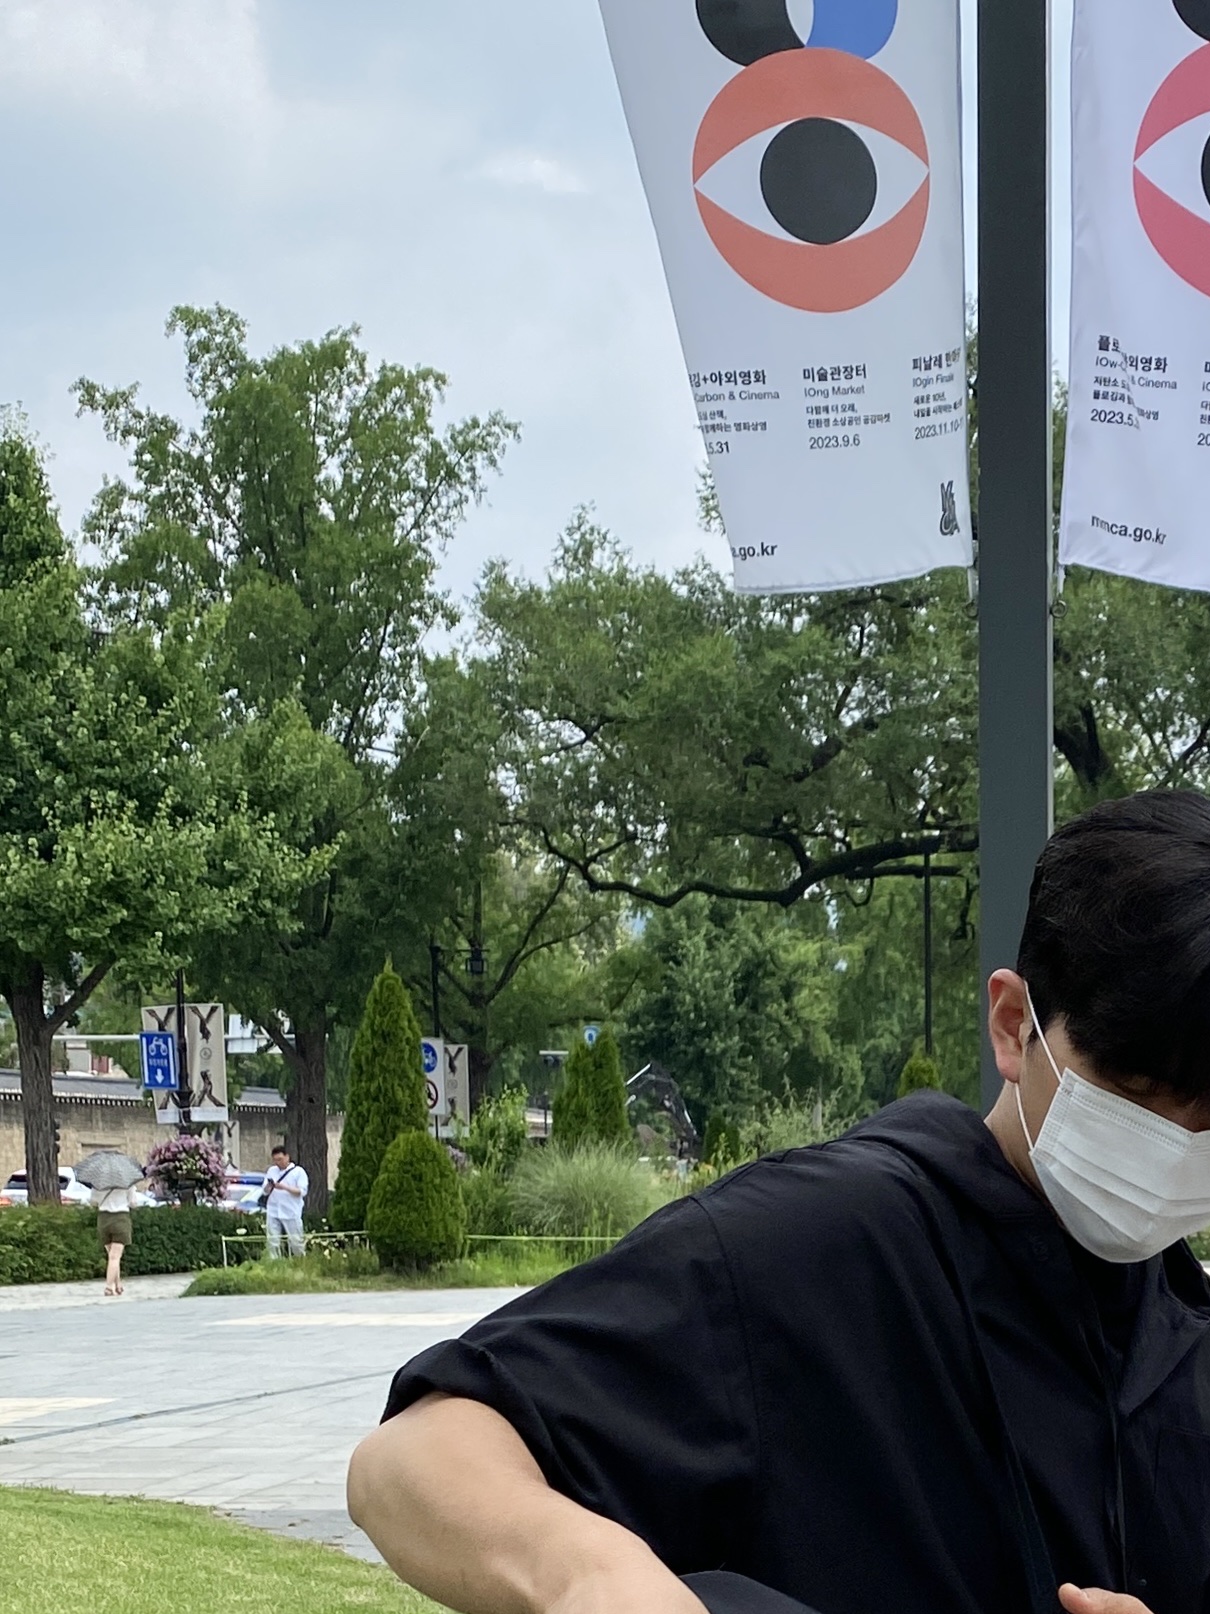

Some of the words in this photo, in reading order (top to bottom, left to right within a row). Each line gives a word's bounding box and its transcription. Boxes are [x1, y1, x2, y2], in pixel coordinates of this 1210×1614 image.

[912, 353, 943, 372] 피날레
[803, 363, 867, 383] 미술관장터
[832, 384, 865, 396] Market
[1137, 376, 1177, 390] Cinema
[739, 390, 780, 401] Cinema
[831, 404, 839, 414] 더
[809, 433, 861, 450] 2023.9.6
[1090, 513, 1167, 546] mmca.go.kr
